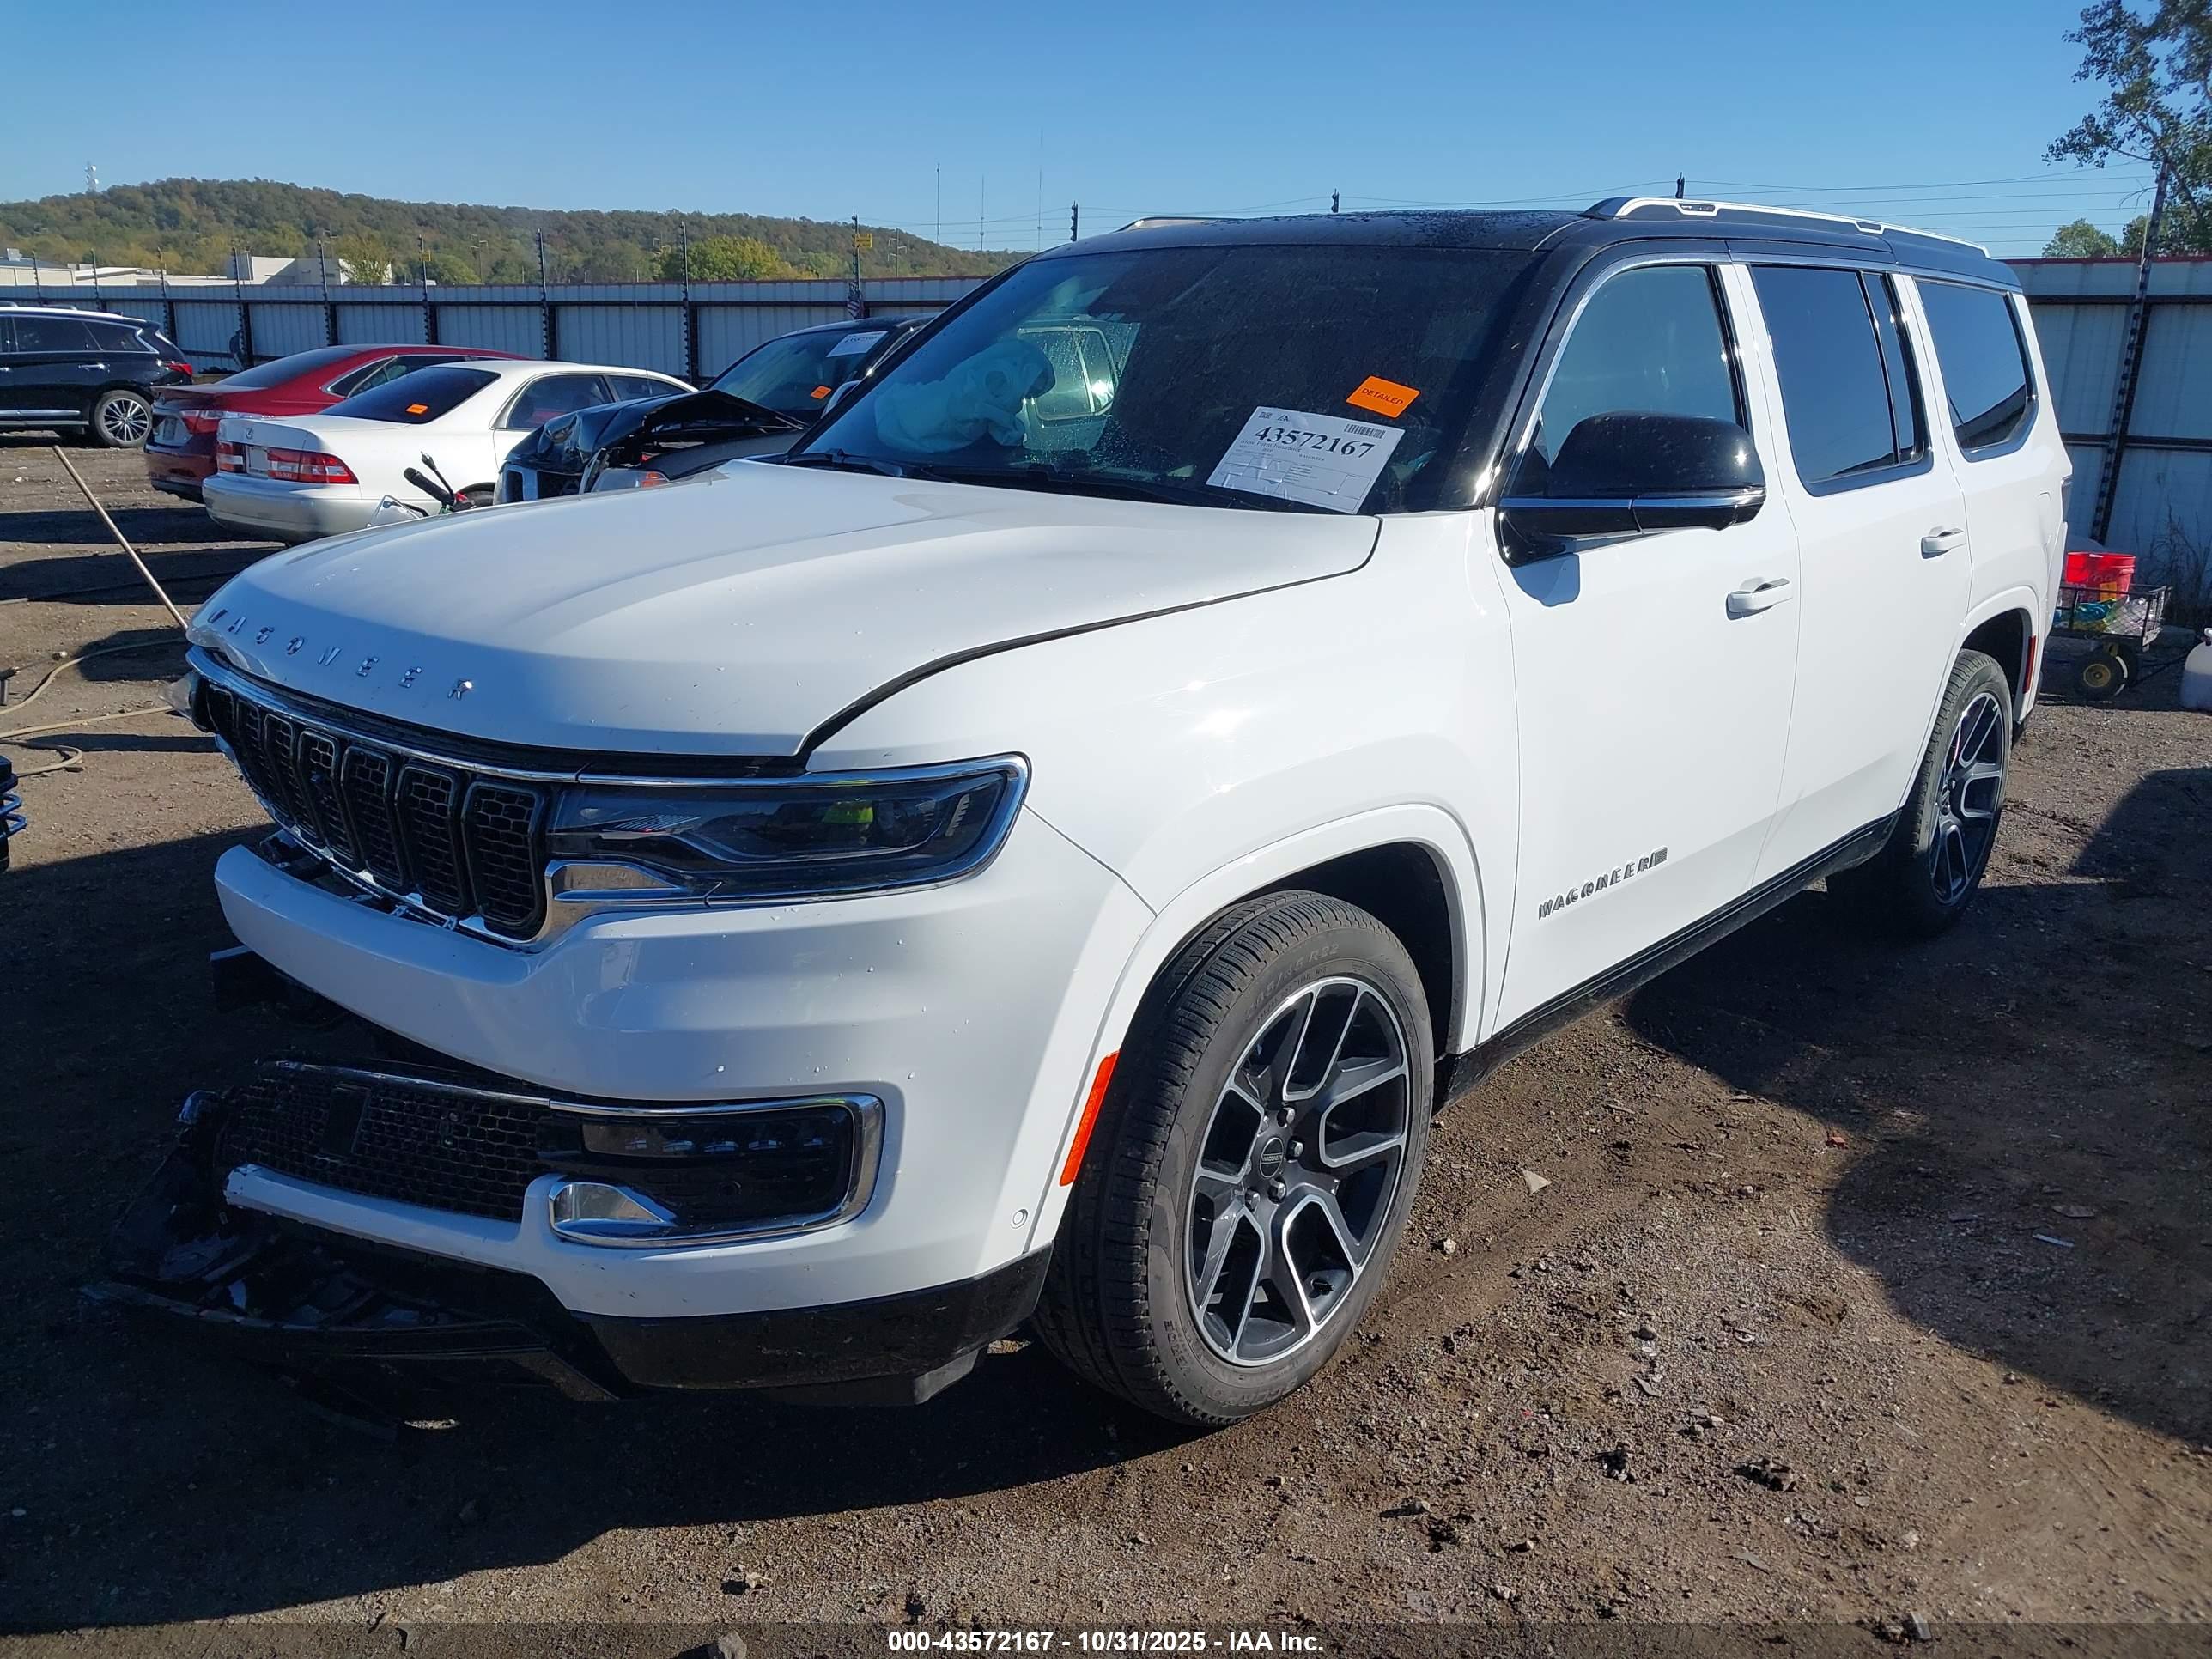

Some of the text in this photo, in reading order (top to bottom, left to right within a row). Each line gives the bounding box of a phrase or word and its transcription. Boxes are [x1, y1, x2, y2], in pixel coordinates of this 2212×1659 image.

[1361, 388, 1404, 405] DETAILED
[1255, 426, 1376, 459] 43572167
[1538, 856, 1650, 921] WAGONEER
